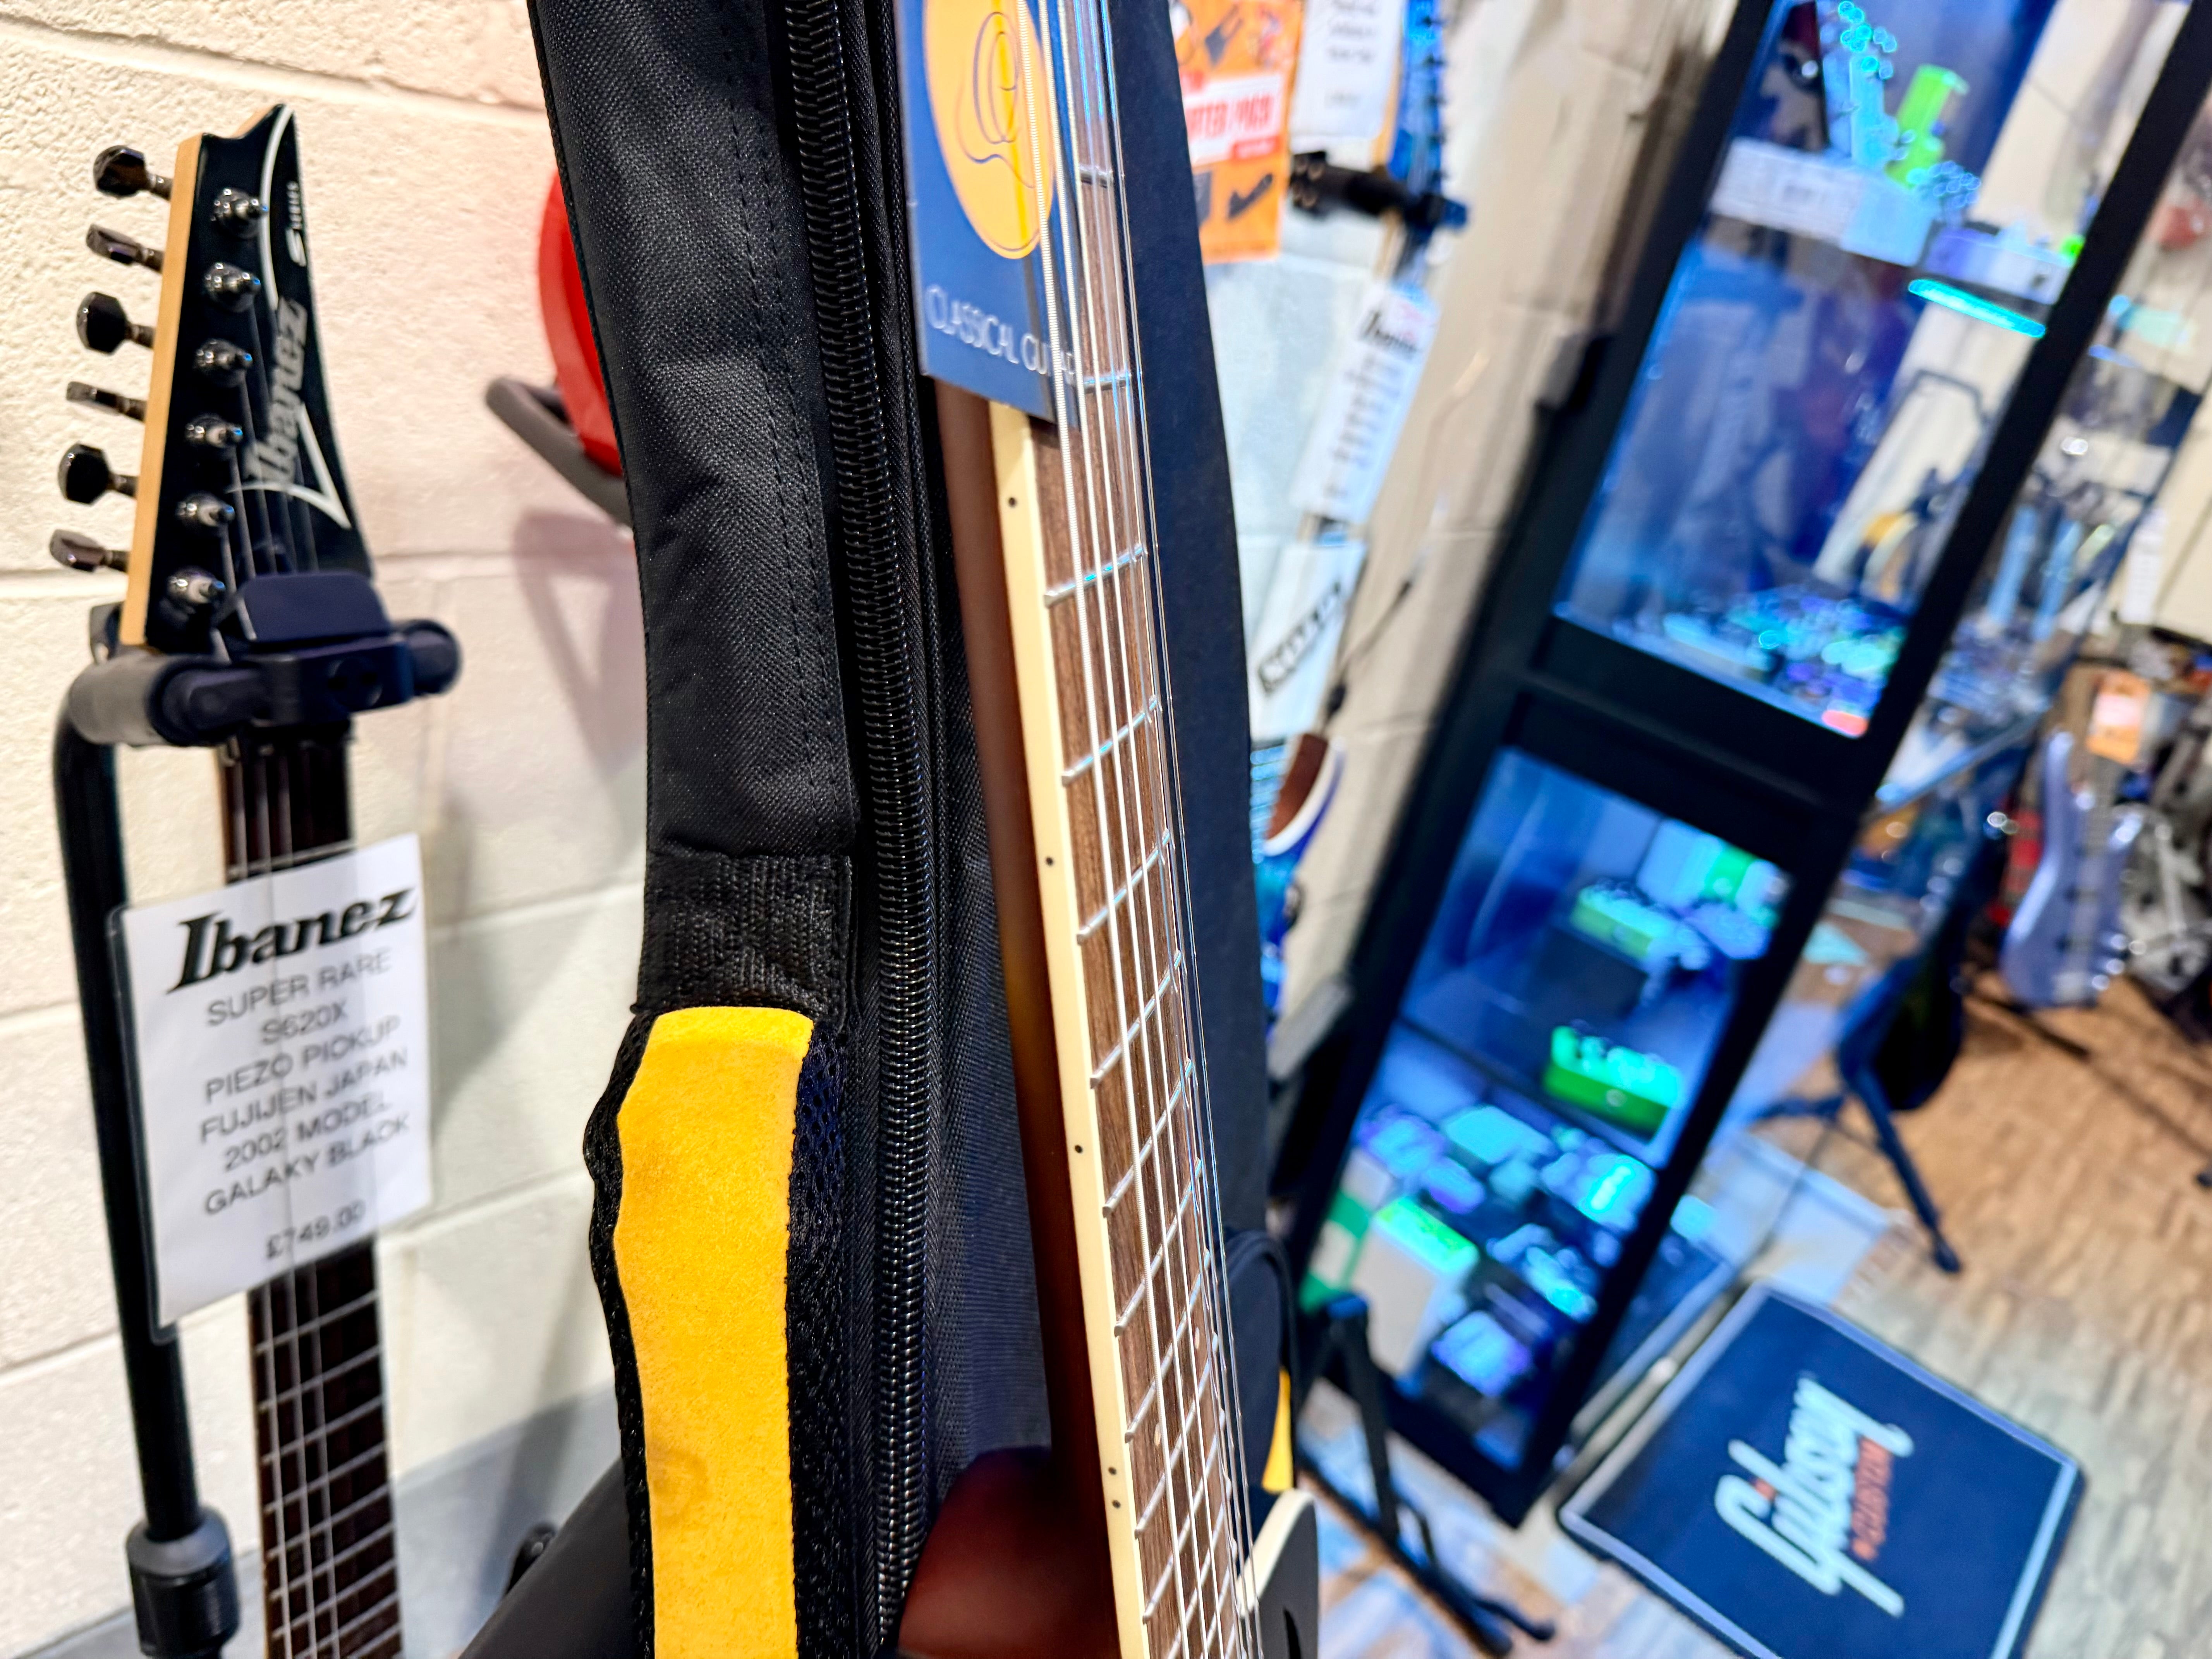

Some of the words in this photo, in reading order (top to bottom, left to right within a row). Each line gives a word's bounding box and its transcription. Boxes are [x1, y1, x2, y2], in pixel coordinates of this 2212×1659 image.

[167, 888, 417, 994] Ibanez
[206, 973, 311, 1027] SUPER
[318, 946, 392, 990] RARE
[205, 1052, 294, 1104] PIEZO
[301, 1015, 401, 1070] PICKUP
[325, 1046, 408, 1098] JAPAN
[225, 1127, 286, 1171] 2002
[296, 1090, 392, 1142] MODEL
[328, 1111, 410, 1167] BLACK
